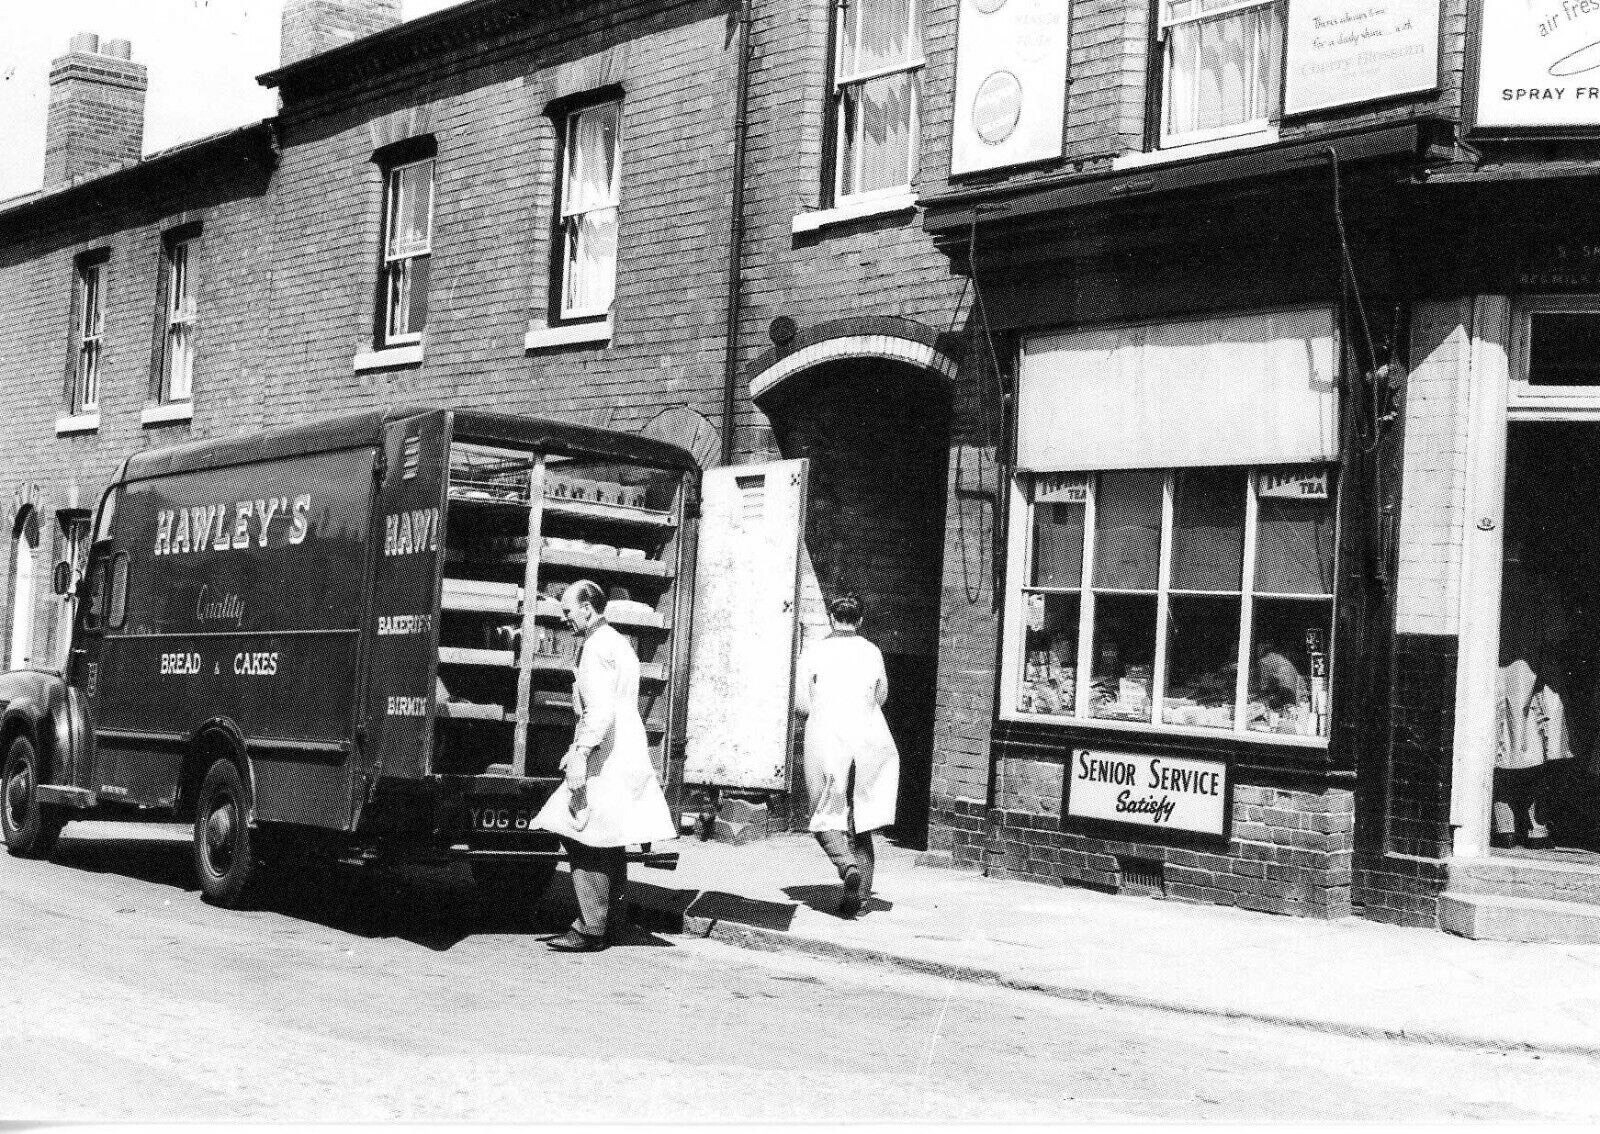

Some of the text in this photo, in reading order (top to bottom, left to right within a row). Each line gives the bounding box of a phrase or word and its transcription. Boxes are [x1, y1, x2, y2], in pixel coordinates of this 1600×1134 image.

[1539, 13, 1559, 38] air
[1501, 87, 1566, 101] SPRAY
[1299, 482, 1325, 495] TEA
[153, 493, 311, 556] HAWLEY'S
[159, 652, 201, 675] BREAD
[233, 652, 279, 676] CAKES
[1078, 750, 1220, 797] SENIOR SERVICE
[1115, 789, 1176, 824] Satisfy
